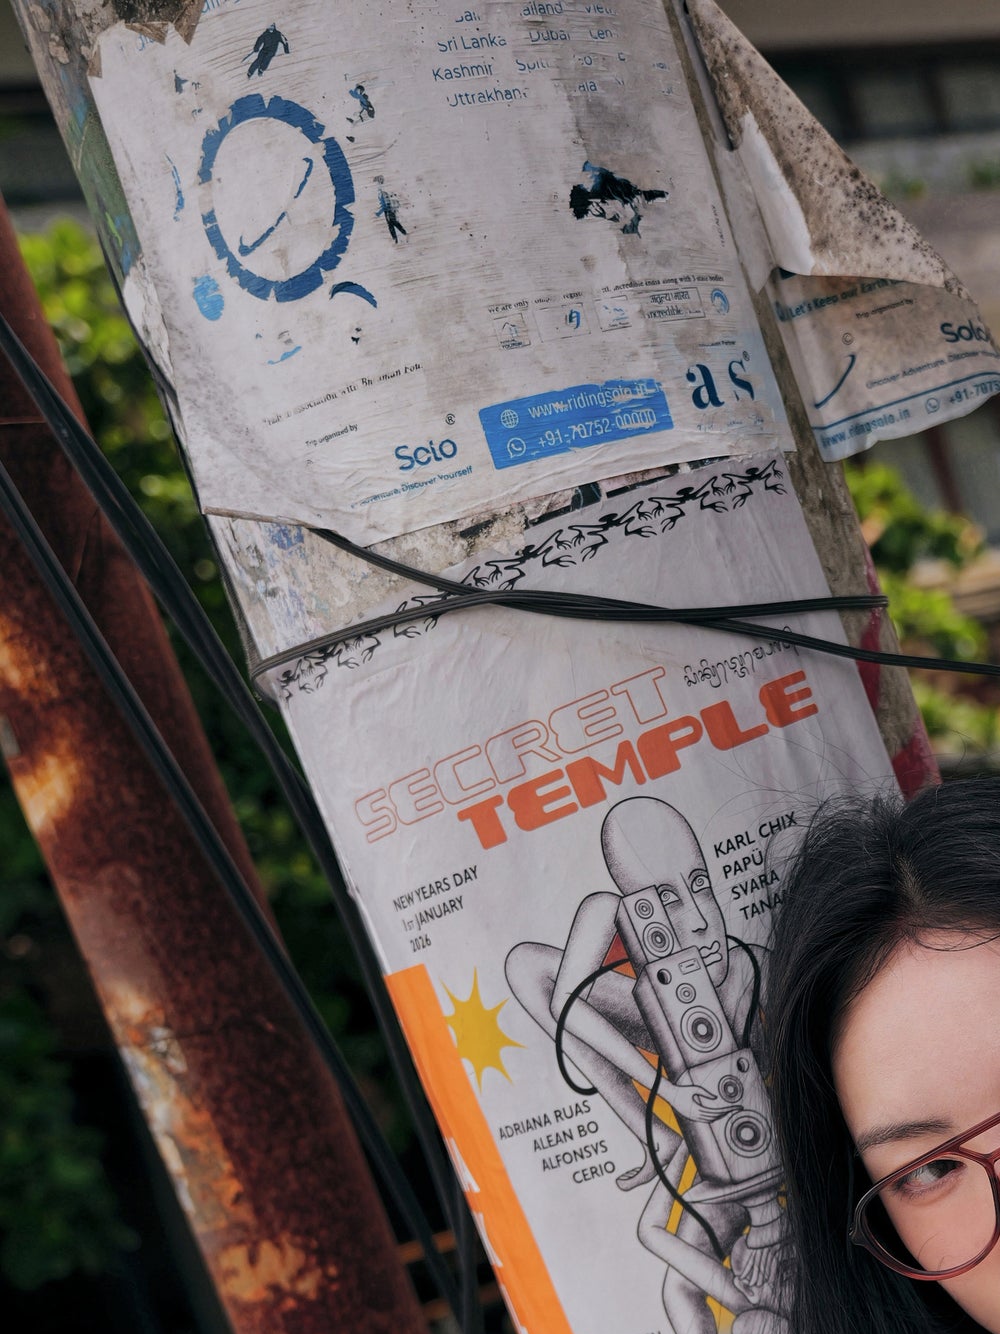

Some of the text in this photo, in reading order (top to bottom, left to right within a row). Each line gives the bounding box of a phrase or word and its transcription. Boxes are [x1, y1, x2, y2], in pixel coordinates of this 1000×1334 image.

[432, 62, 493, 82] Kashmir
[355, 666, 668, 843] SECRET
[457, 670, 819, 850] TEMPLE
[713, 811, 798, 858] KARL CHIX
[722, 848, 764, 879] PAPÜ
[393, 865, 479, 912] NEW YEARS DAY
[731, 869, 780, 900] SVARA
[415, 895, 464, 931] JANUARY
[410, 934, 432, 953] 2026
[499, 1099, 592, 1141] ADRIANA RUAS
[533, 1120, 599, 1152] ALEAN BO
[542, 1139, 608, 1172] ALFONSVS
[572, 1160, 616, 1184] CERIO
